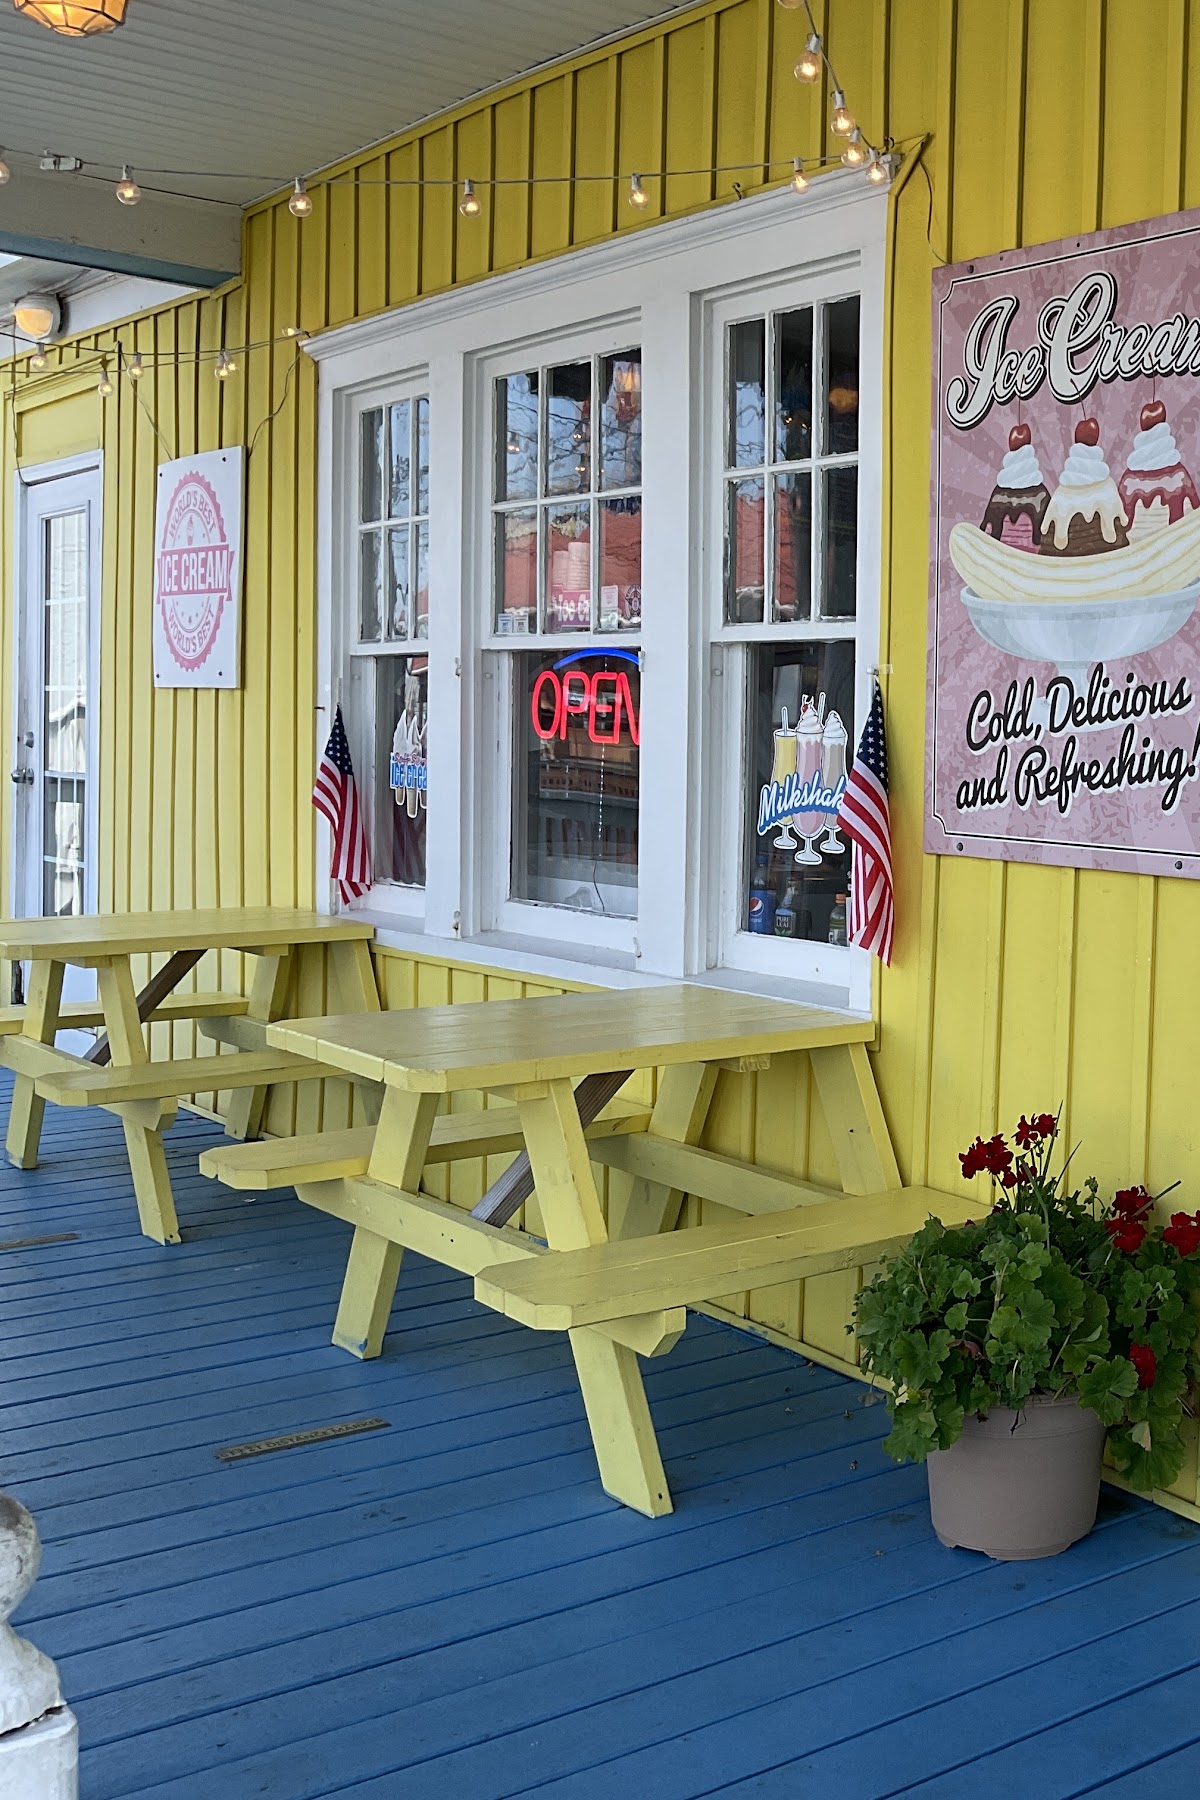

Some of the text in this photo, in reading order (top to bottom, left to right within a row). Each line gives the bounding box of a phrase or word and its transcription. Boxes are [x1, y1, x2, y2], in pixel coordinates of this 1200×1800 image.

[946, 295, 1045, 430] Ice
[168, 490, 217, 539] WORLD'S BEST
[161, 549, 228, 593] ICE CREAM
[168, 603, 215, 654] WORLD'S BEST
[966, 661, 1196, 752] Cold, Delicious
[759, 770, 846, 829] Milkshak
[956, 744, 1008, 811] and
